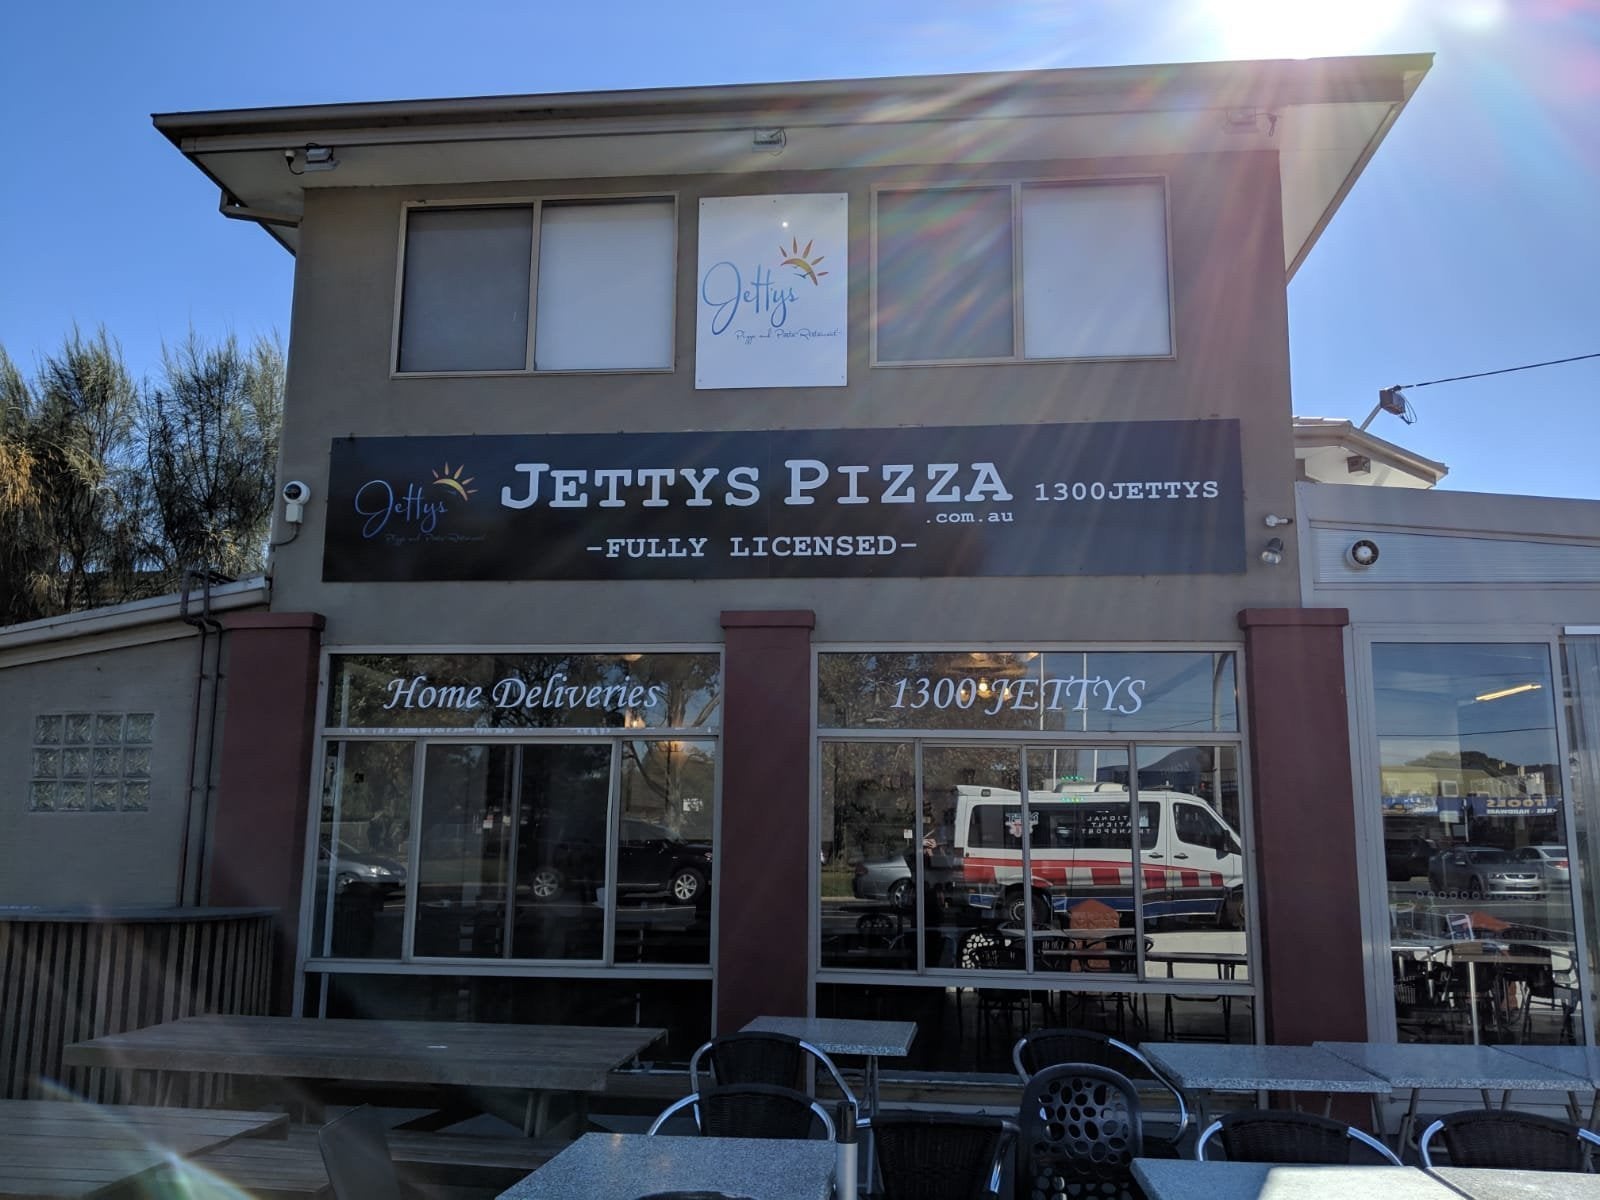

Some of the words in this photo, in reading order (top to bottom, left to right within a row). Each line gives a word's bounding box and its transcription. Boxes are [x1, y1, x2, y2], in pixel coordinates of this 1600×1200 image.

[702, 261, 799, 335] Jettys
[501, 463, 760, 509] JETTYS
[783, 459, 1014, 506] PIZZA
[1034, 480, 1220, 501] 1300JETTYS
[354, 479, 448, 538] Jettys
[926, 509, 1014, 524] .com.au
[383, 675, 482, 709] Home
[492, 673, 661, 709] Deliveries
[890, 677, 977, 709] 1300
[984, 675, 1145, 716] JETTYS
